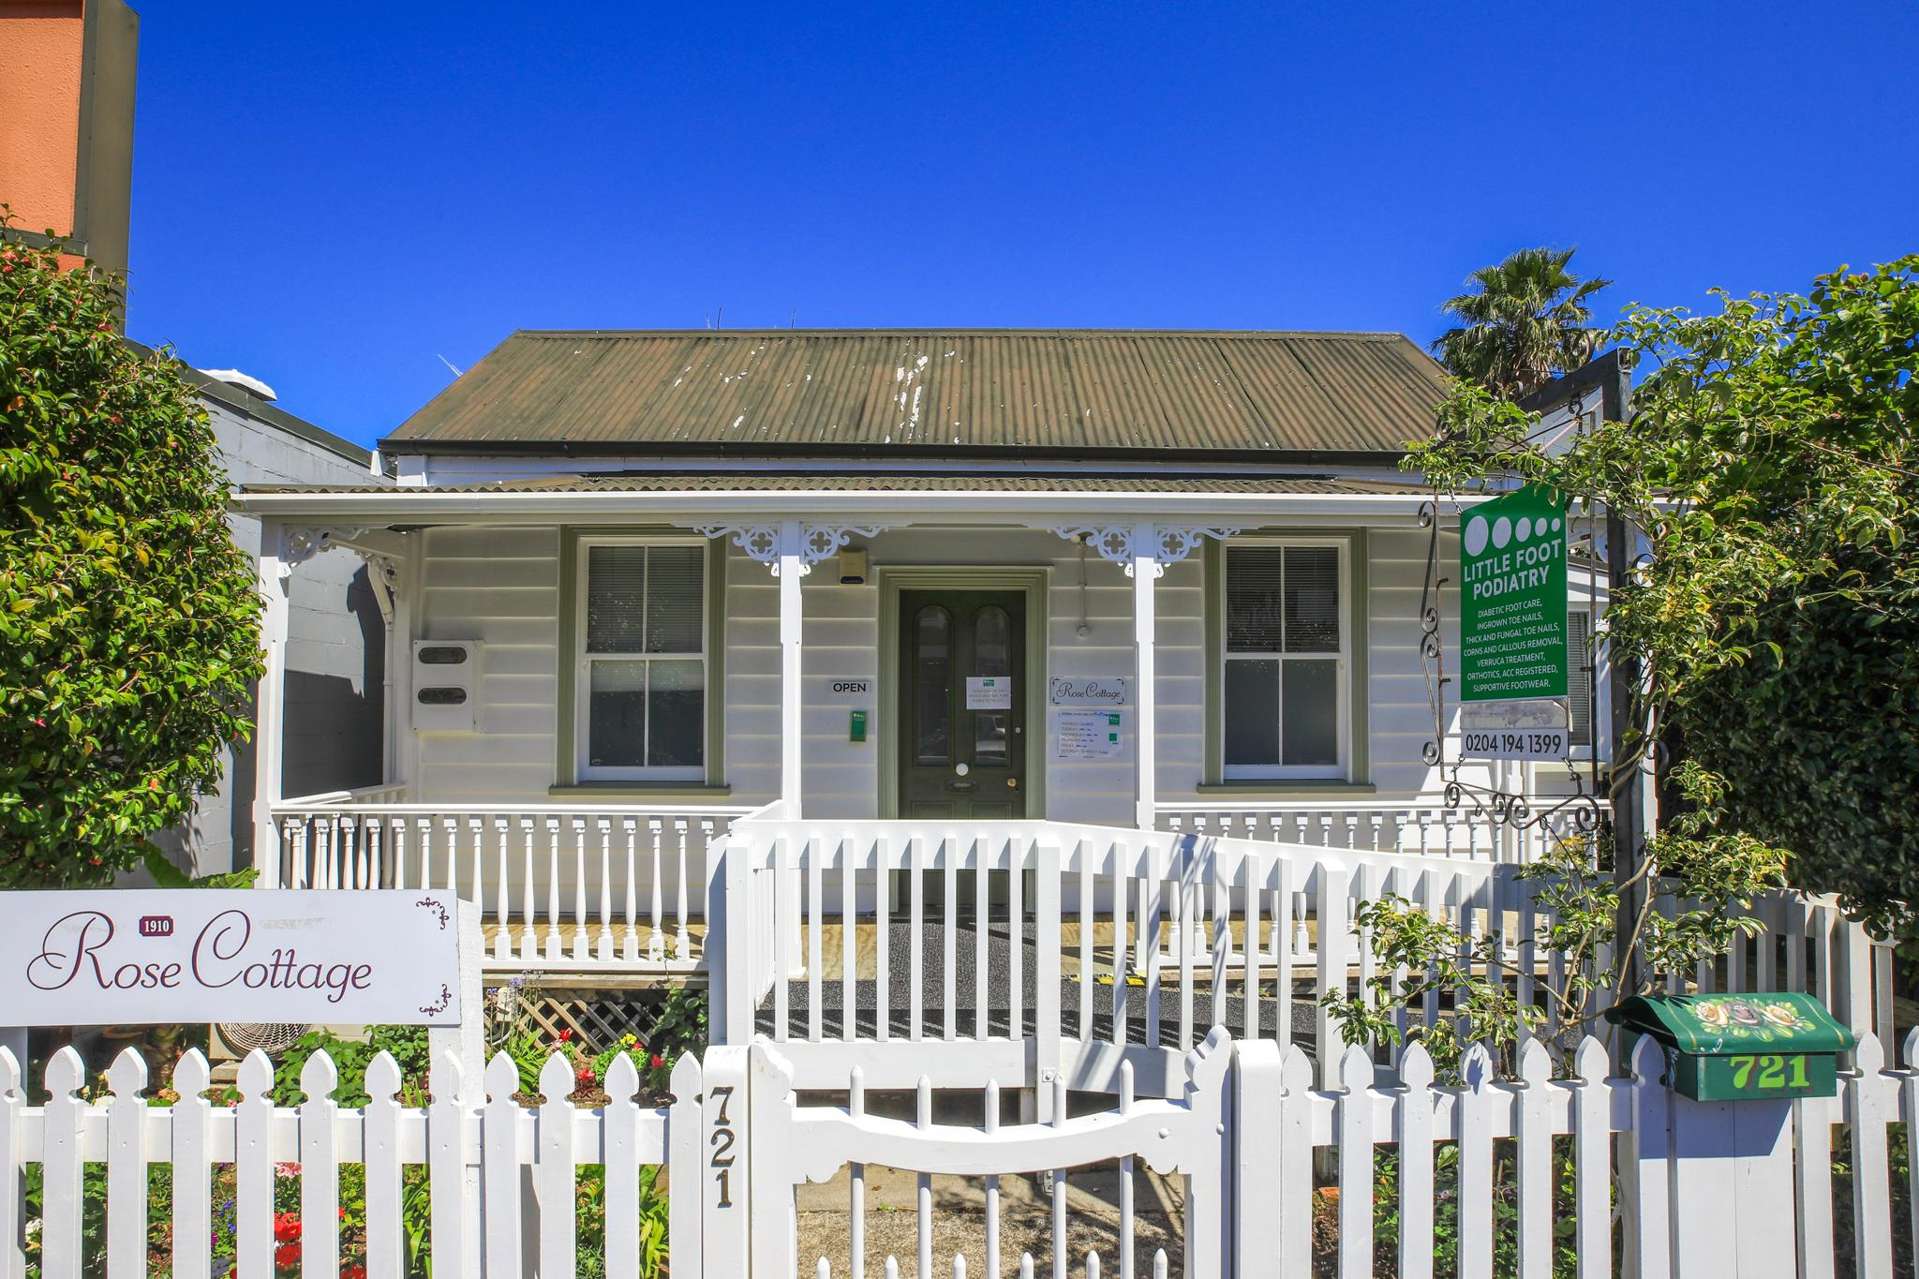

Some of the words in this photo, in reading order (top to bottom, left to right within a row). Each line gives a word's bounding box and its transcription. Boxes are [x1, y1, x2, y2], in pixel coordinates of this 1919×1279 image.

[1463, 553, 1510, 583] LITTLE
[1516, 538, 1562, 568] FOOT
[1473, 565, 1550, 601] PODIATRY
[1478, 606, 1504, 618] DIABETIC
[1505, 601, 1522, 612] FOOT
[1477, 618, 1507, 630] INGROWN
[1508, 615, 1520, 625] TOE
[1522, 611, 1544, 622] NAILS,
[1466, 634, 1482, 644] THICK
[1482, 632, 1496, 642] AND
[1497, 629, 1522, 640] FUNGAL
[1524, 625, 1536, 635] TOE
[1537, 622, 1560, 633] NAILS,
[1464, 646, 1483, 657] CORNS
[1484, 645, 1497, 654] AND
[1498, 641, 1526, 652] CALLOUS
[1527, 636, 1563, 648] REMOVAL,
[1476, 656, 1504, 667] VERRUCA
[1506, 651, 1546, 663] TREATMENT,
[1467, 669, 1501, 681] ORTHOTICS,
[1502, 668, 1515, 677] ACC
[1516, 664, 1559, 676] REGISTERED,
[833, 682, 867, 693] OPEN
[1056, 682, 1085, 698] Rose
[1086, 682, 1121, 701] Cottage
[1473, 681, 1510, 693] SUPPORTIVE
[1511, 679, 1551, 690] FOOTWEAR.
[1465, 734, 1498, 752] 0204
[1501, 734, 1525, 753] 194
[1528, 734, 1562, 754] 1399
[144, 919, 171, 934] 1910
[26, 910, 182, 991] Rose
[191, 909, 373, 1004] Cottage
[1728, 1055, 1810, 1089] 721
[709, 1086, 736, 1209] 721
